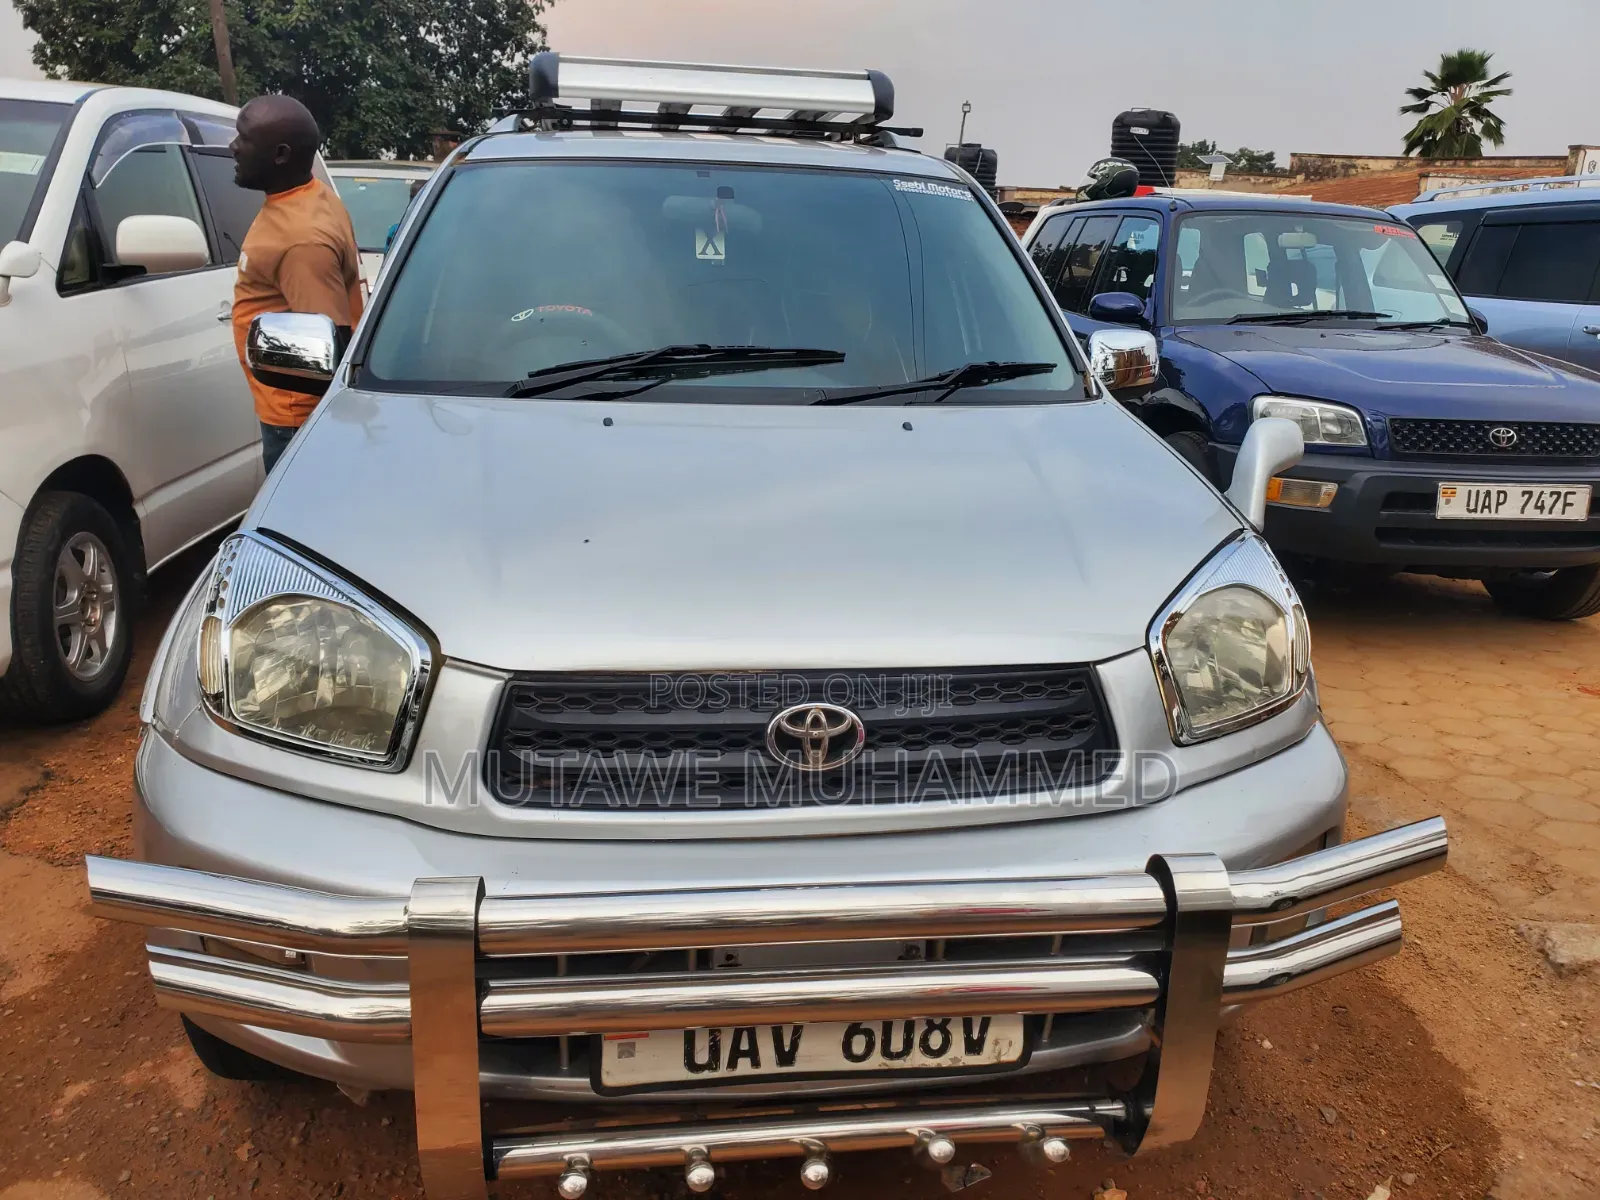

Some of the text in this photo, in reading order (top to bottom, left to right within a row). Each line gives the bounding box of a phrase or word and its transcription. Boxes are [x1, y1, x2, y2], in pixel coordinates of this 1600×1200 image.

[537, 304, 593, 317] TOYOTA
[1465, 489, 1577, 516] UAP 747F
[683, 1016, 992, 1074] UAV 608V
